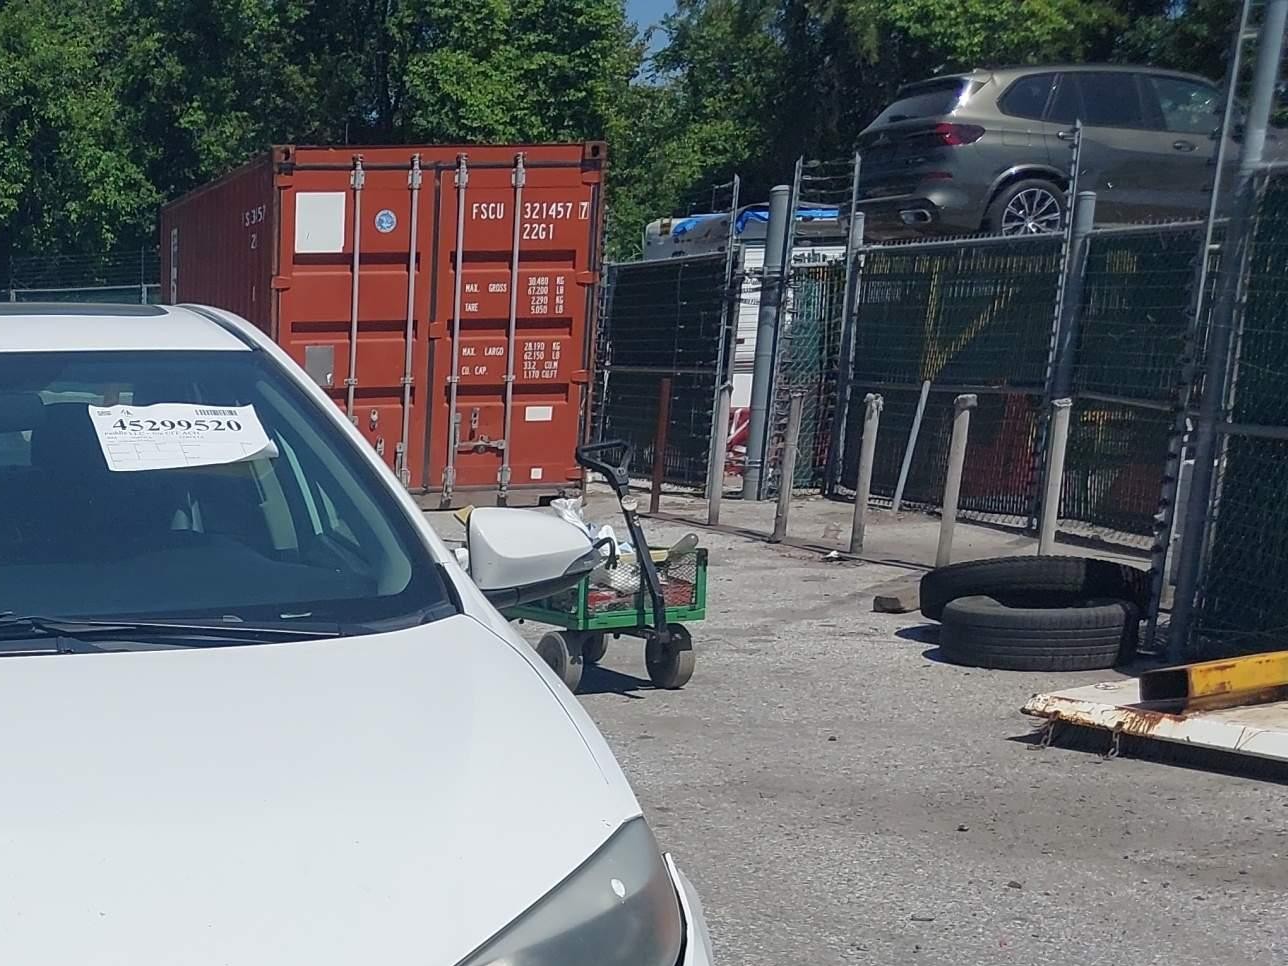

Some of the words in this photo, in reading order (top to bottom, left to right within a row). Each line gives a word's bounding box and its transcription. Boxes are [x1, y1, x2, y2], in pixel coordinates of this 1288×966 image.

[472, 202, 505, 220] FSCU
[523, 202, 573, 220] 321457
[579, 201, 590, 220] 7
[522, 223, 554, 240] 22G1
[556, 276, 565, 285] KG
[488, 283, 508, 293] GROSS
[556, 286, 565, 295] LB
[555, 295, 564, 304] KG
[465, 302, 479, 312] TARE
[555, 305, 564, 313] LB
[552, 341, 561, 351] KG
[552, 351, 560, 360] LB
[112, 417, 242, 432] 45299520
